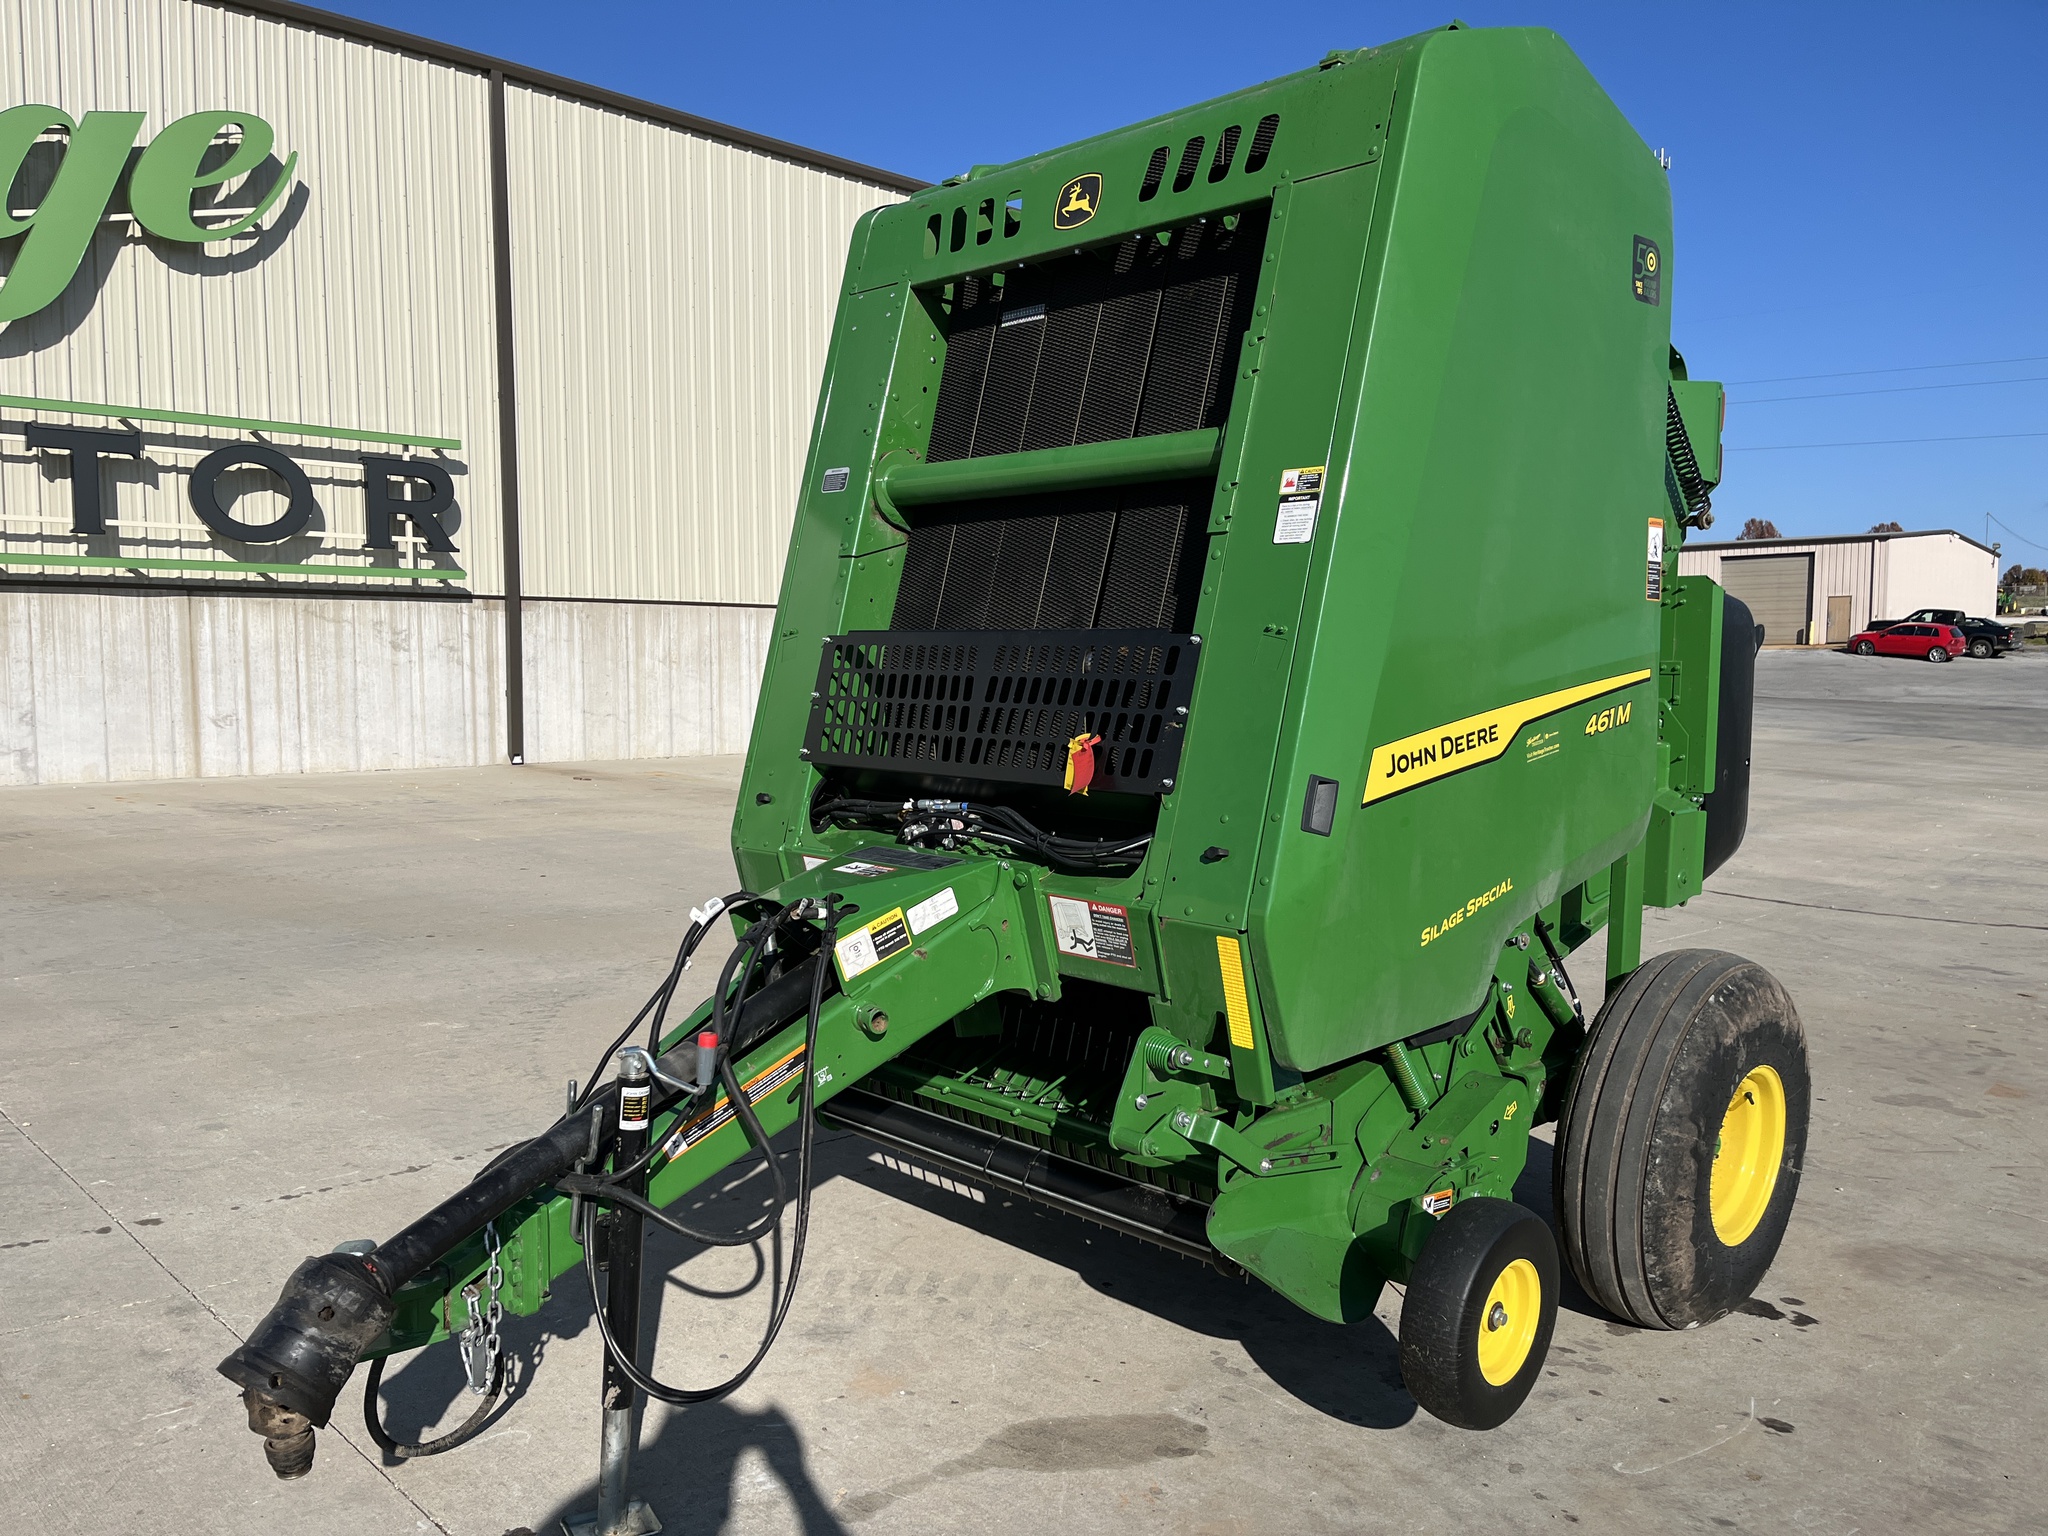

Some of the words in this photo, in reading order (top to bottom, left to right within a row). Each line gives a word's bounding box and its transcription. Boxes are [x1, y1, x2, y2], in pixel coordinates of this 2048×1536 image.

[26, 422, 460, 553] TOR
[1386, 744, 1437, 778] JOHN
[1440, 723, 1499, 759] DEERE
[876, 913, 898, 928] CAUTION
[1098, 905, 1122, 915] DANGER
[1420, 907, 1465, 947] SILAGE
[1466, 877, 1514, 917] SPECIAL
